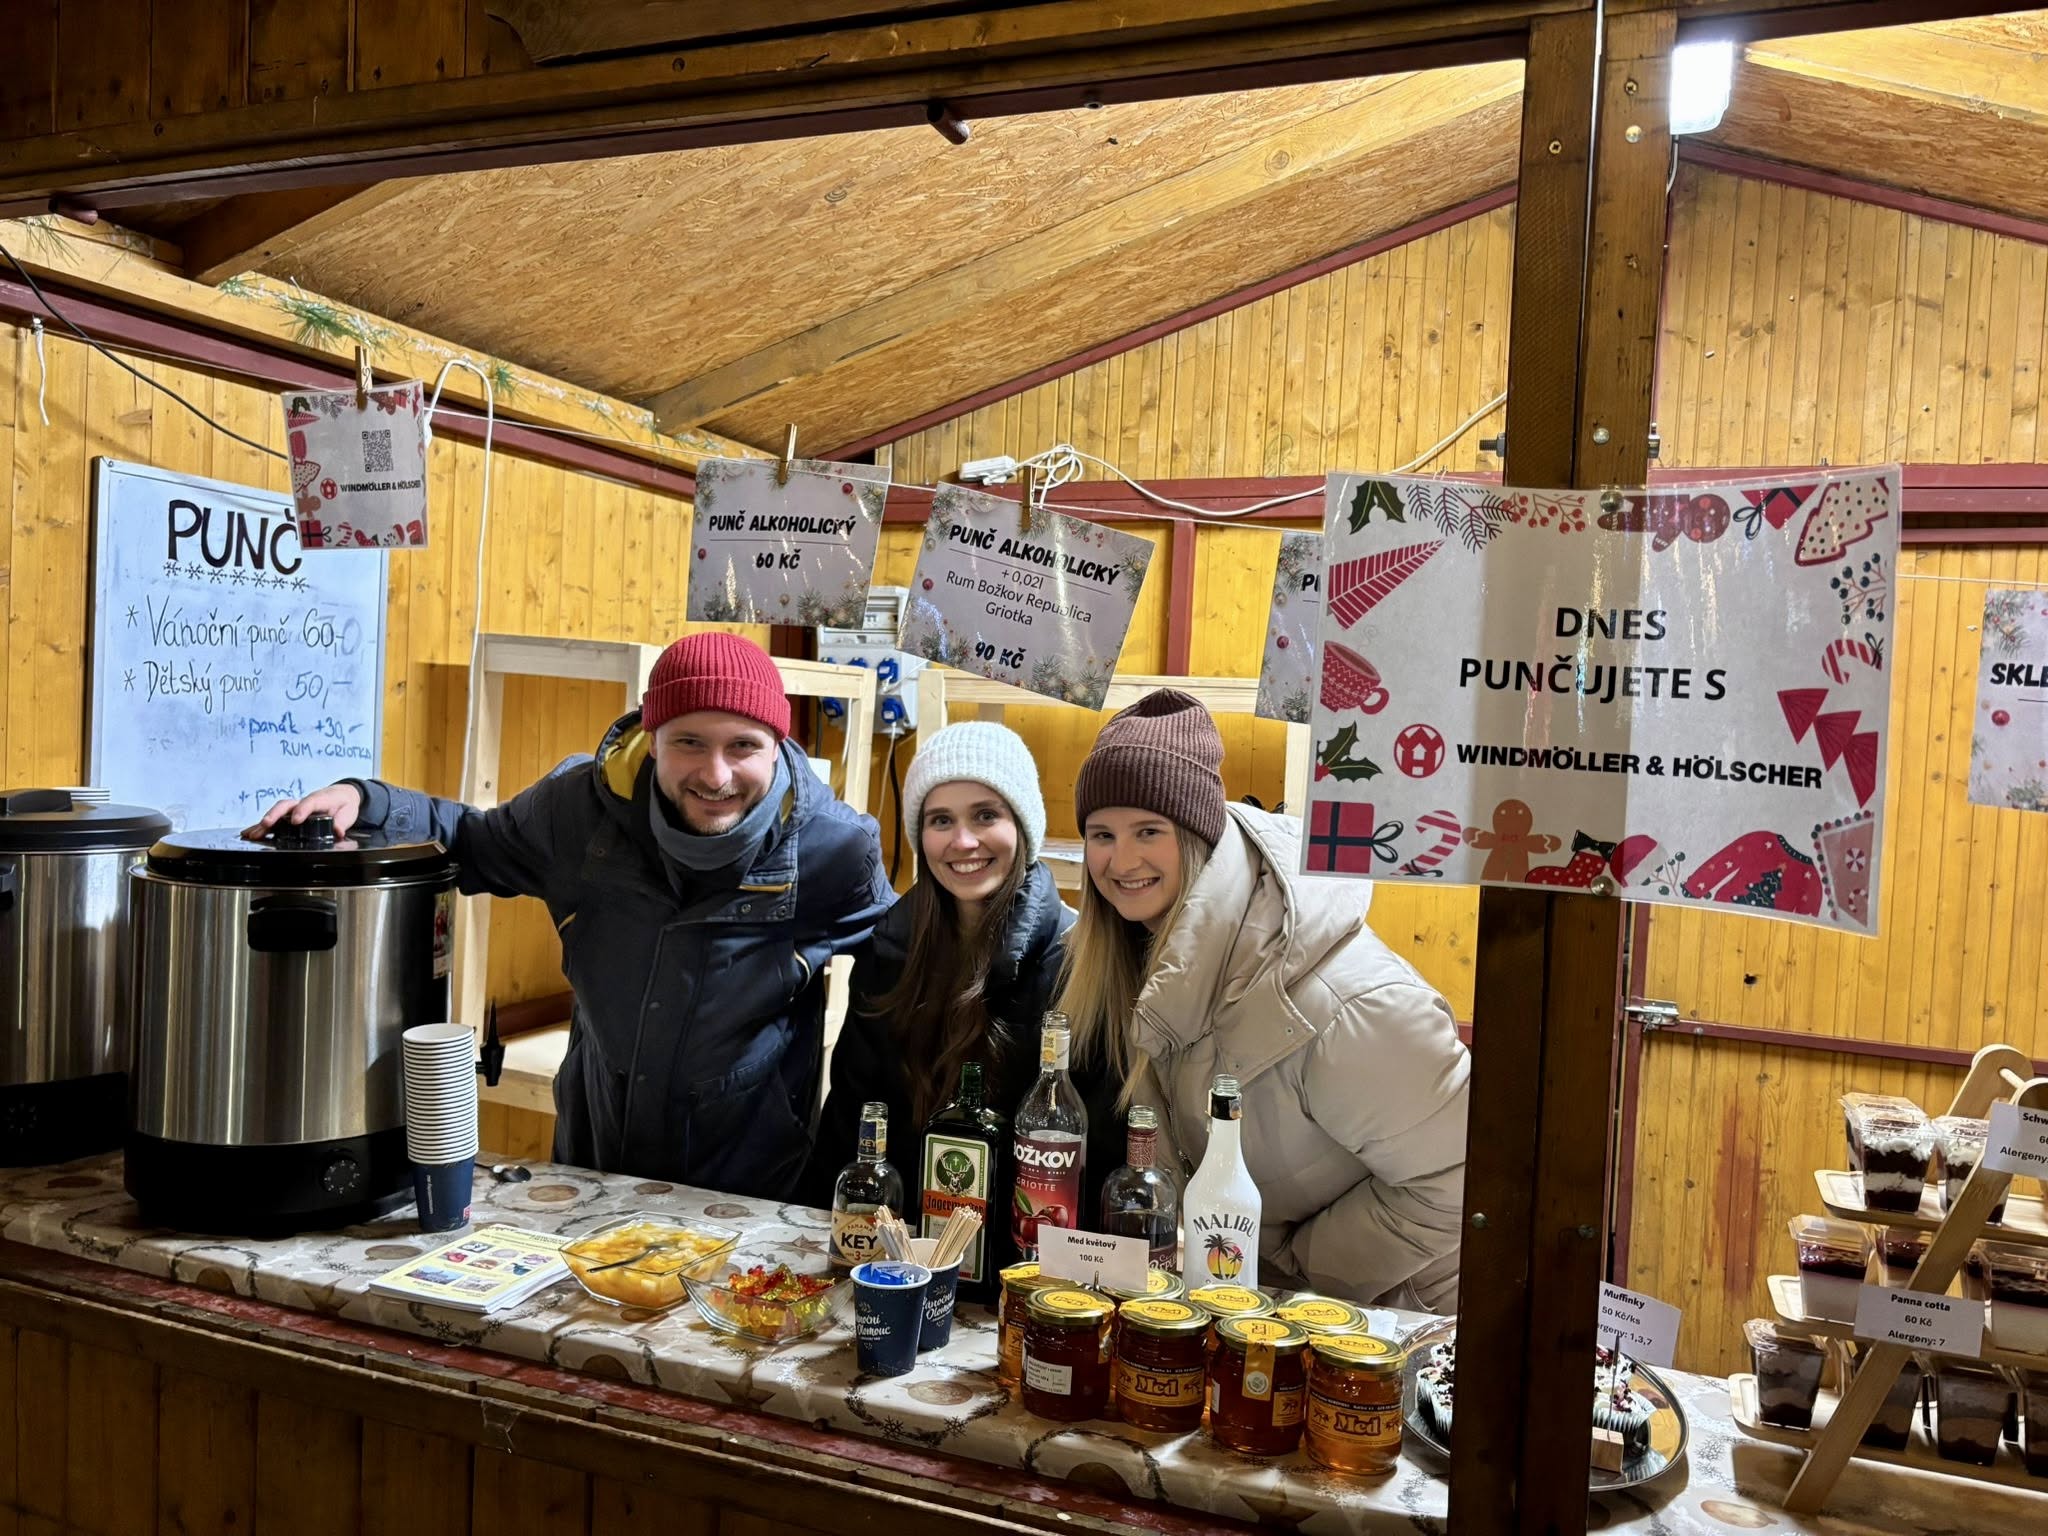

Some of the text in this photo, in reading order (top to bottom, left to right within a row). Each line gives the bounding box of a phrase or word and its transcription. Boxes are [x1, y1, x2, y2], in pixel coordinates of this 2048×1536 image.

[340, 482, 391, 492] WINDMÖLLER
[708, 510, 856, 535] PUNČ ALKOHOLICKÝ
[168, 499, 302, 575] PUNČ
[756, 549, 801, 569] 60 KČ
[949, 525, 1121, 586] PUNČ ALKOHOLICKÝ
[946, 570, 1092, 623] Rum Božkov Republica
[985, 602, 1033, 626] Griotka
[1555, 607, 1667, 641] DNES
[147, 595, 243, 648] Vánoční
[249, 614, 289, 661] punč
[975, 641, 1026, 669] 90 KČ
[143, 660, 213, 714] Dětský
[219, 668, 262, 712] punč
[1459, 655, 1727, 704] PUNČUJETE S
[280, 740, 313, 758] RUM
[1456, 744, 1823, 789] WINDMÖLLER & HÖLSCHER
[1016, 1177, 1056, 1191] GRIOTTE
[1193, 1213, 1257, 1238] MALIBU
[841, 1232, 878, 1250] KEY
[1067, 1236, 1117, 1250] Med květový
[854, 1250, 862, 1261] 3
[1079, 1254, 1104, 1264] 100 Kč
[1603, 1288, 1646, 1310] Muffinky
[1891, 1294, 1951, 1312] Panna cotta
[1602, 1306, 1641, 1326] 50 Kč/ks
[1904, 1314, 1933, 1327] 60 Kč
[1600, 1323, 1653, 1346] rgeny: 1,3,7
[1888, 1329, 1946, 1347] Alergeny: 7
[1135, 1373, 1179, 1397] Med
[1333, 1411, 1382, 1437] Med
